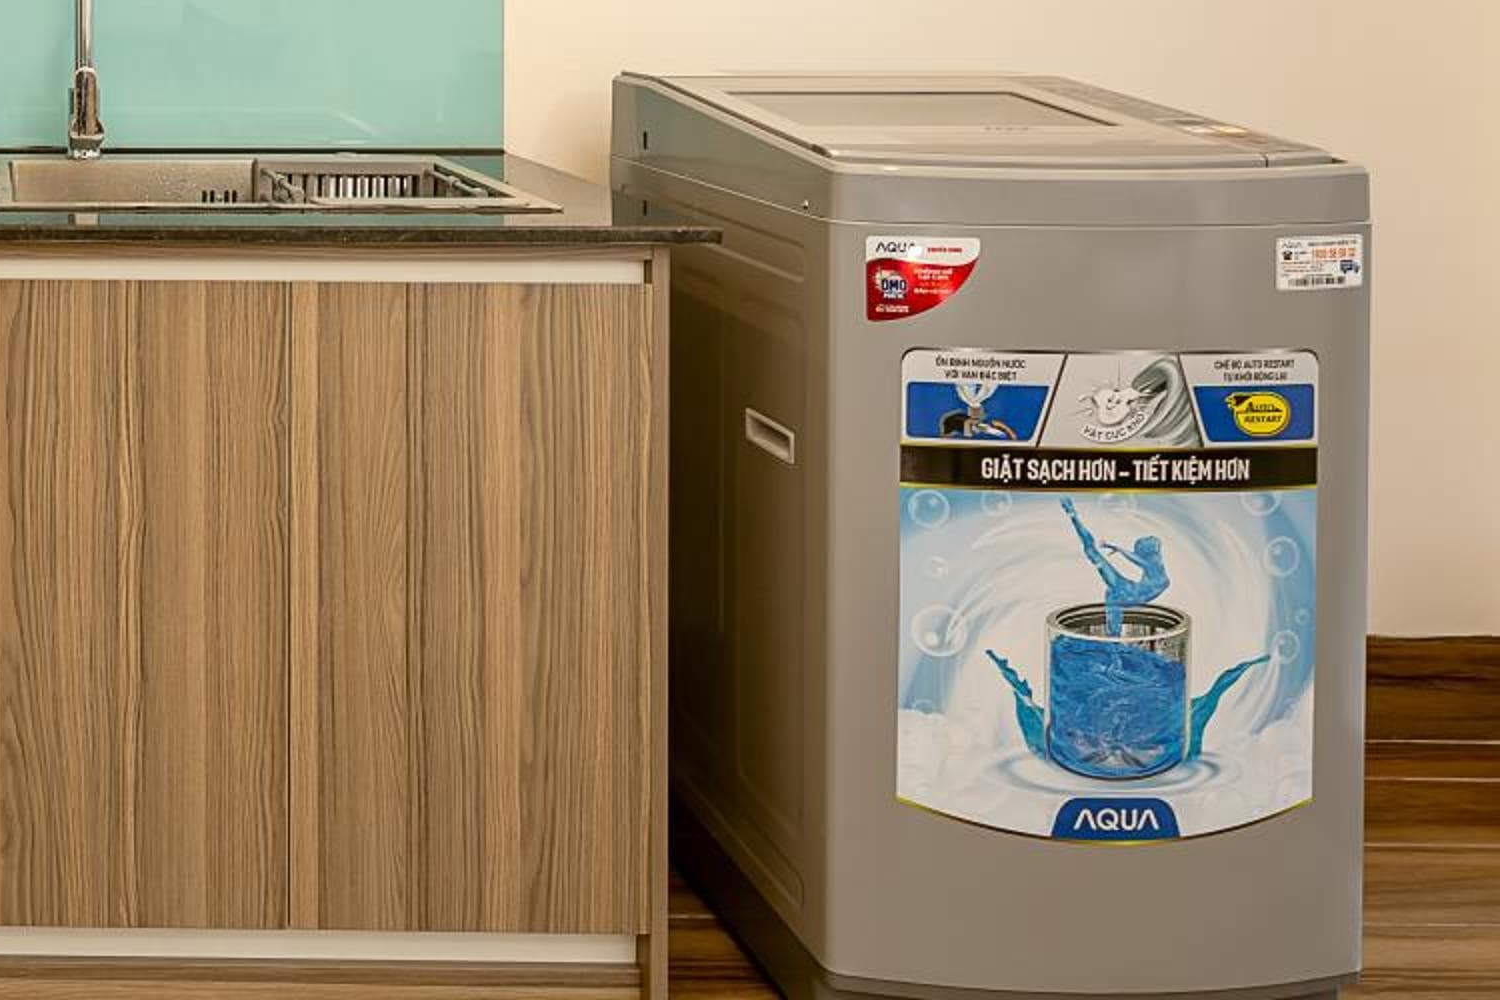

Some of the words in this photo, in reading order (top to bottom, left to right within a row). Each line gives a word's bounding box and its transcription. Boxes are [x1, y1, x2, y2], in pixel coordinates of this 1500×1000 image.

[882, 279, 907, 292] OMO
[1264, 359, 1295, 369] RESTART
[1244, 415, 1282, 423] RESTART
[981, 454, 1024, 483] GIẶT
[1027, 459, 1075, 485] SẠCH
[1133, 454, 1169, 481] TIẾT
[1172, 456, 1212, 485] KIỆM
[1073, 807, 1160, 831] AQUA
